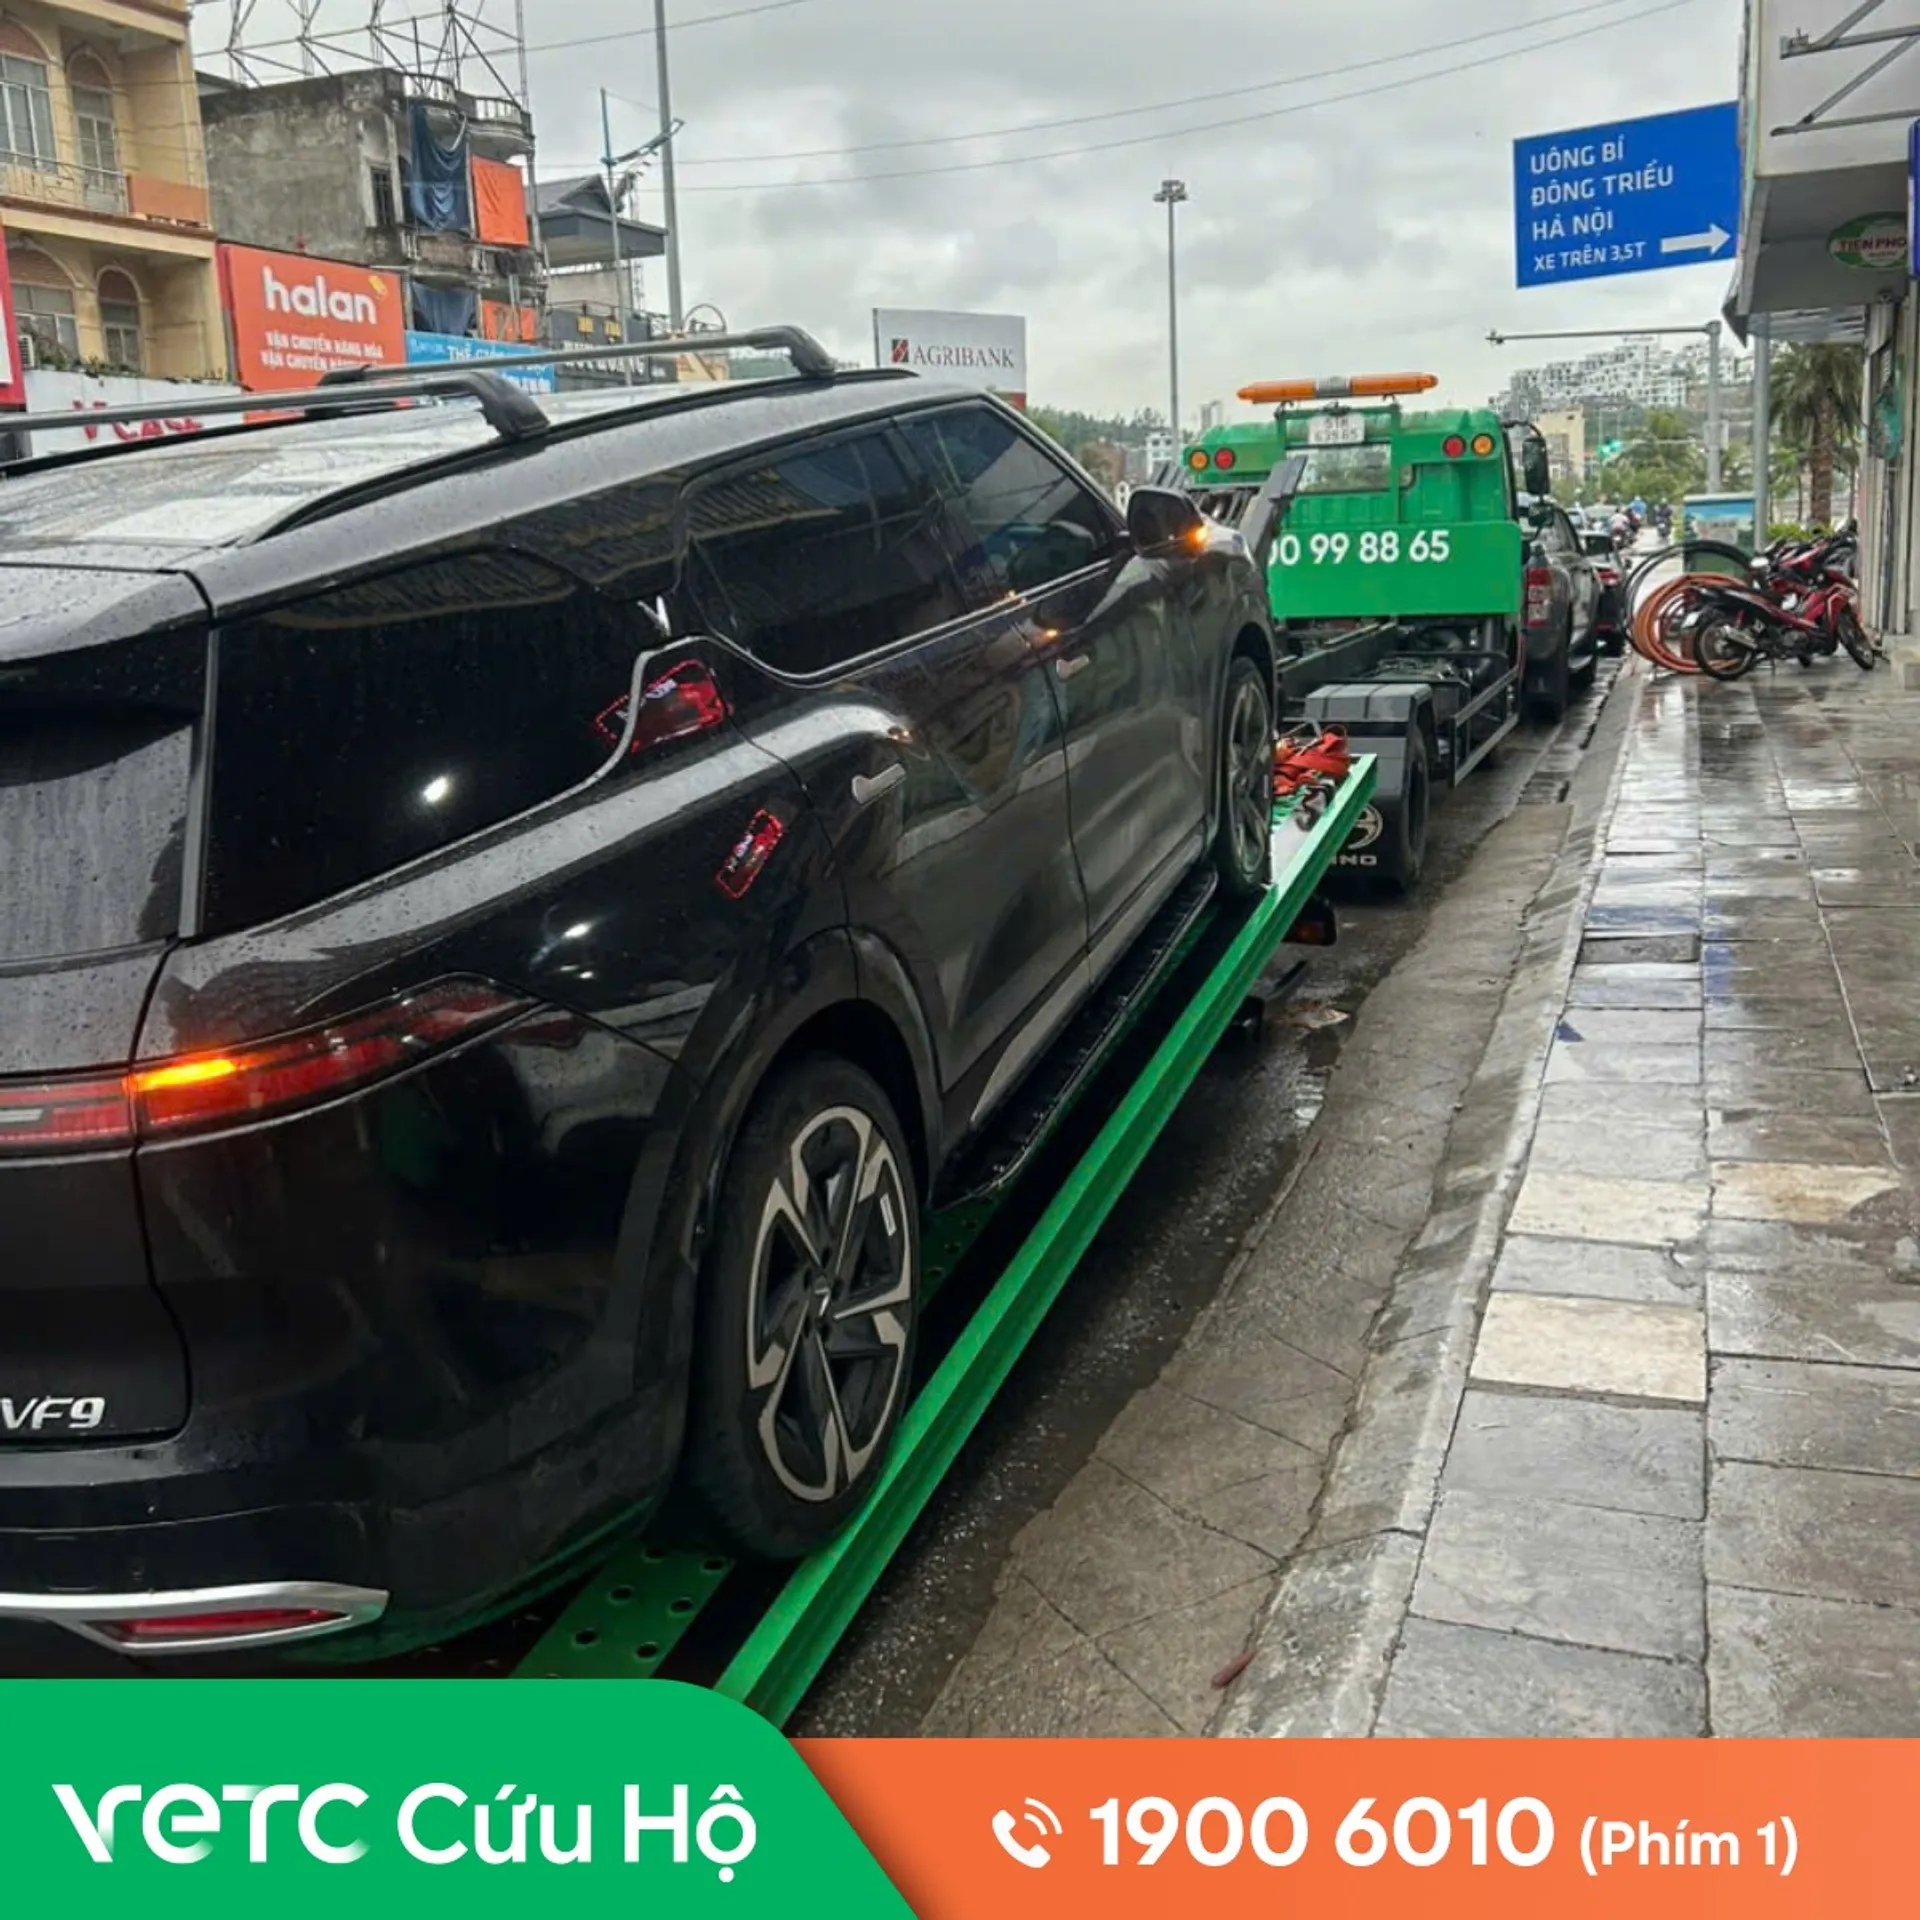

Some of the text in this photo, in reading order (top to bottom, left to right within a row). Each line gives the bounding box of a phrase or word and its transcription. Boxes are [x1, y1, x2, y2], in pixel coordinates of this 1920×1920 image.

[1530, 133, 1625, 175] UÔNG BÍ
[1530, 178, 1596, 208] ĐÔNG
[1572, 206, 1614, 238] NỘI
[1533, 253, 1556, 273] XE
[1560, 243, 1608, 267] TRÊN
[261, 265, 378, 325] halan
[914, 345, 1015, 368] AGRIBANK
[1310, 532, 1349, 564] 99
[1359, 531, 1399, 563] 88
[1409, 530, 1450, 562] 65
[0, 1396, 105, 1430] VF9
